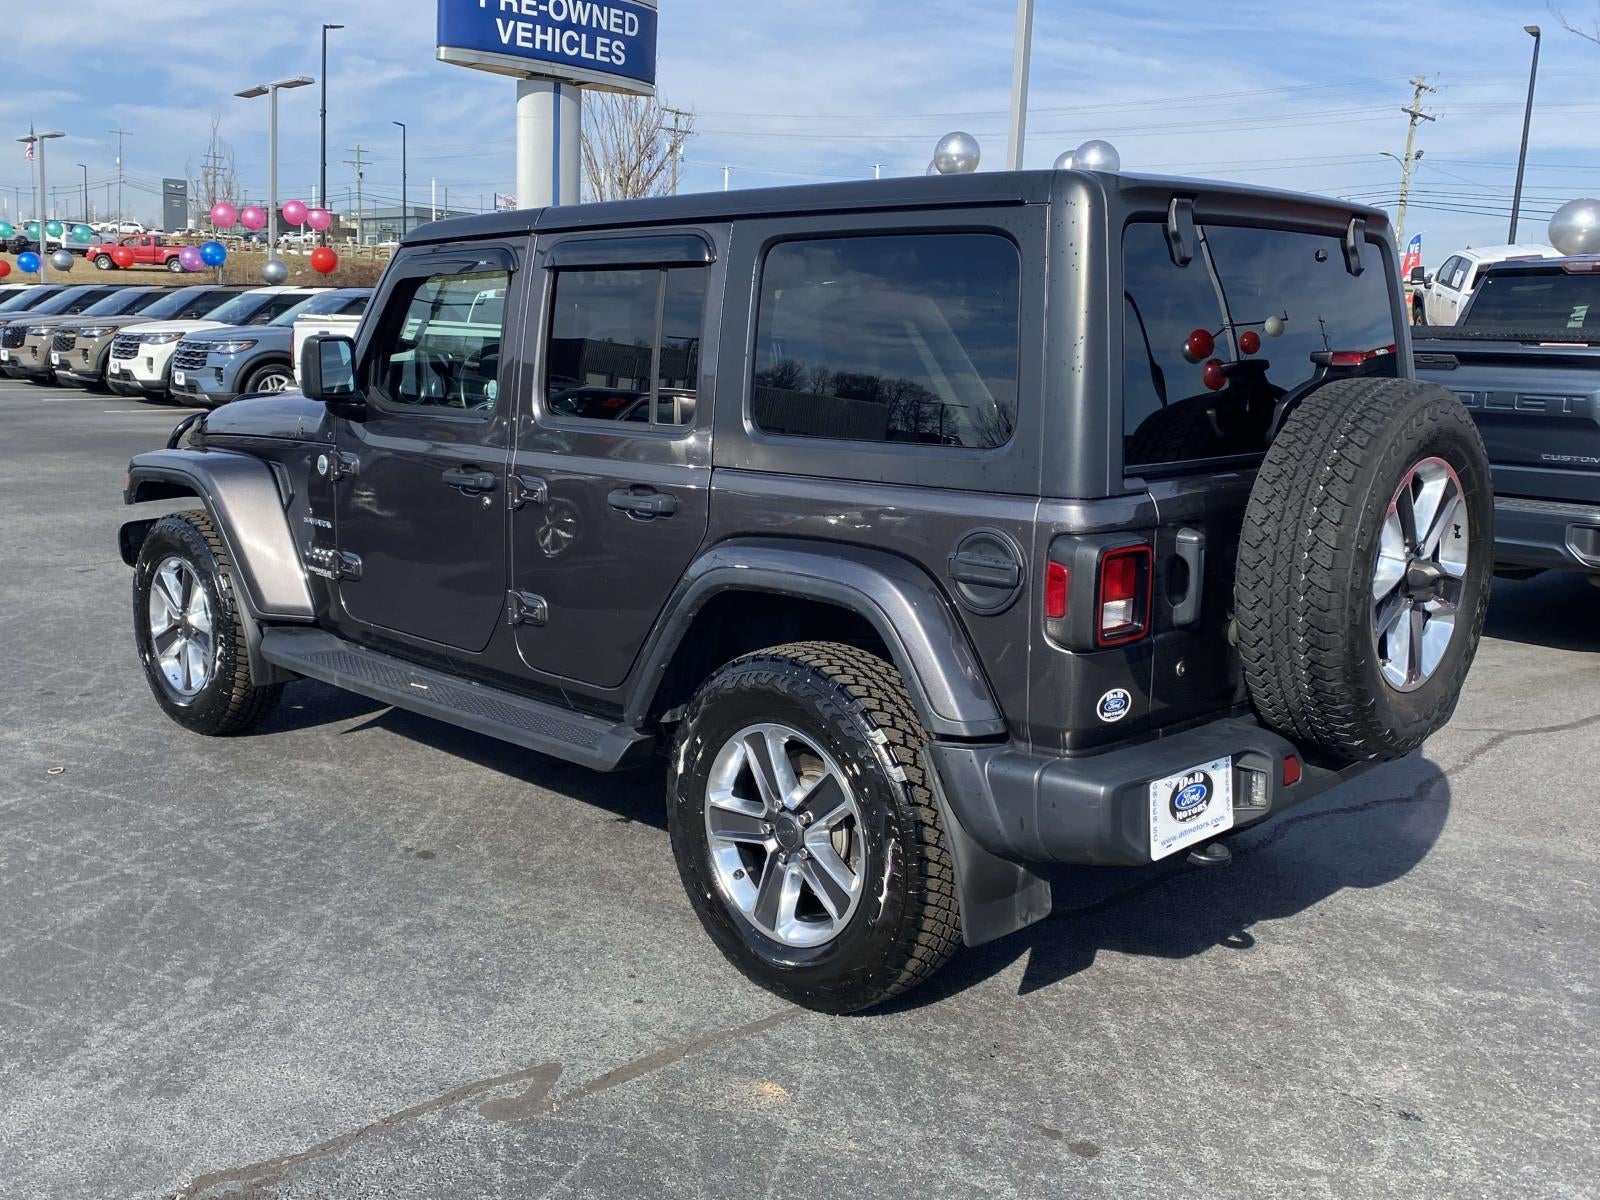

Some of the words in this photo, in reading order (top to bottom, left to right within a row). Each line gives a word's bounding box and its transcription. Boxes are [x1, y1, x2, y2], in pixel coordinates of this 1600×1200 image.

[495, 18, 626, 66] VEHICLES
[1178, 772, 1204, 792] D&D
[1180, 788, 1202, 807] Ford
[1176, 800, 1208, 821] MOTORS
[1161, 815, 1225, 846] www.ddmotors.com
